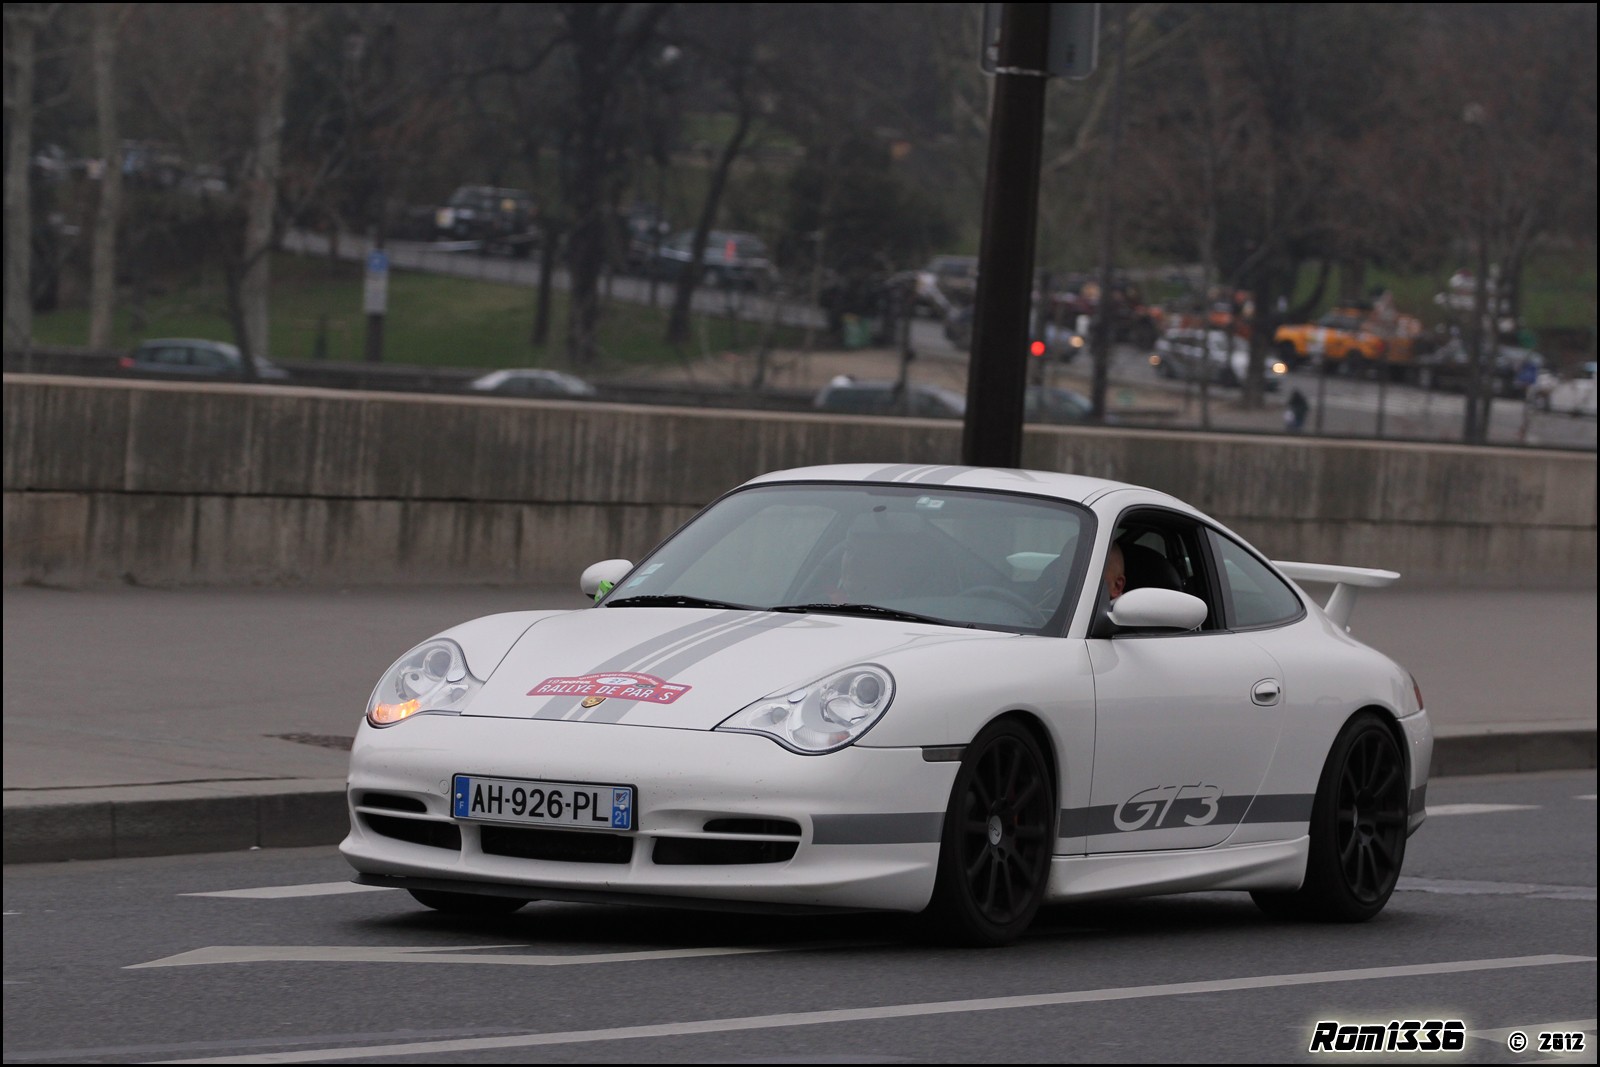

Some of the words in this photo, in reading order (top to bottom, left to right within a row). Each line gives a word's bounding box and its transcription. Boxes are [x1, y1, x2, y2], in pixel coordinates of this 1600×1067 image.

[537, 684, 596, 694] RALLYE
[595, 685, 619, 695] DE
[620, 687, 674, 701] PARS
[458, 801, 465, 810] F
[471, 783, 609, 822] AH-926-PL
[1113, 781, 1224, 832] GT3
[614, 810, 628, 826] 21
